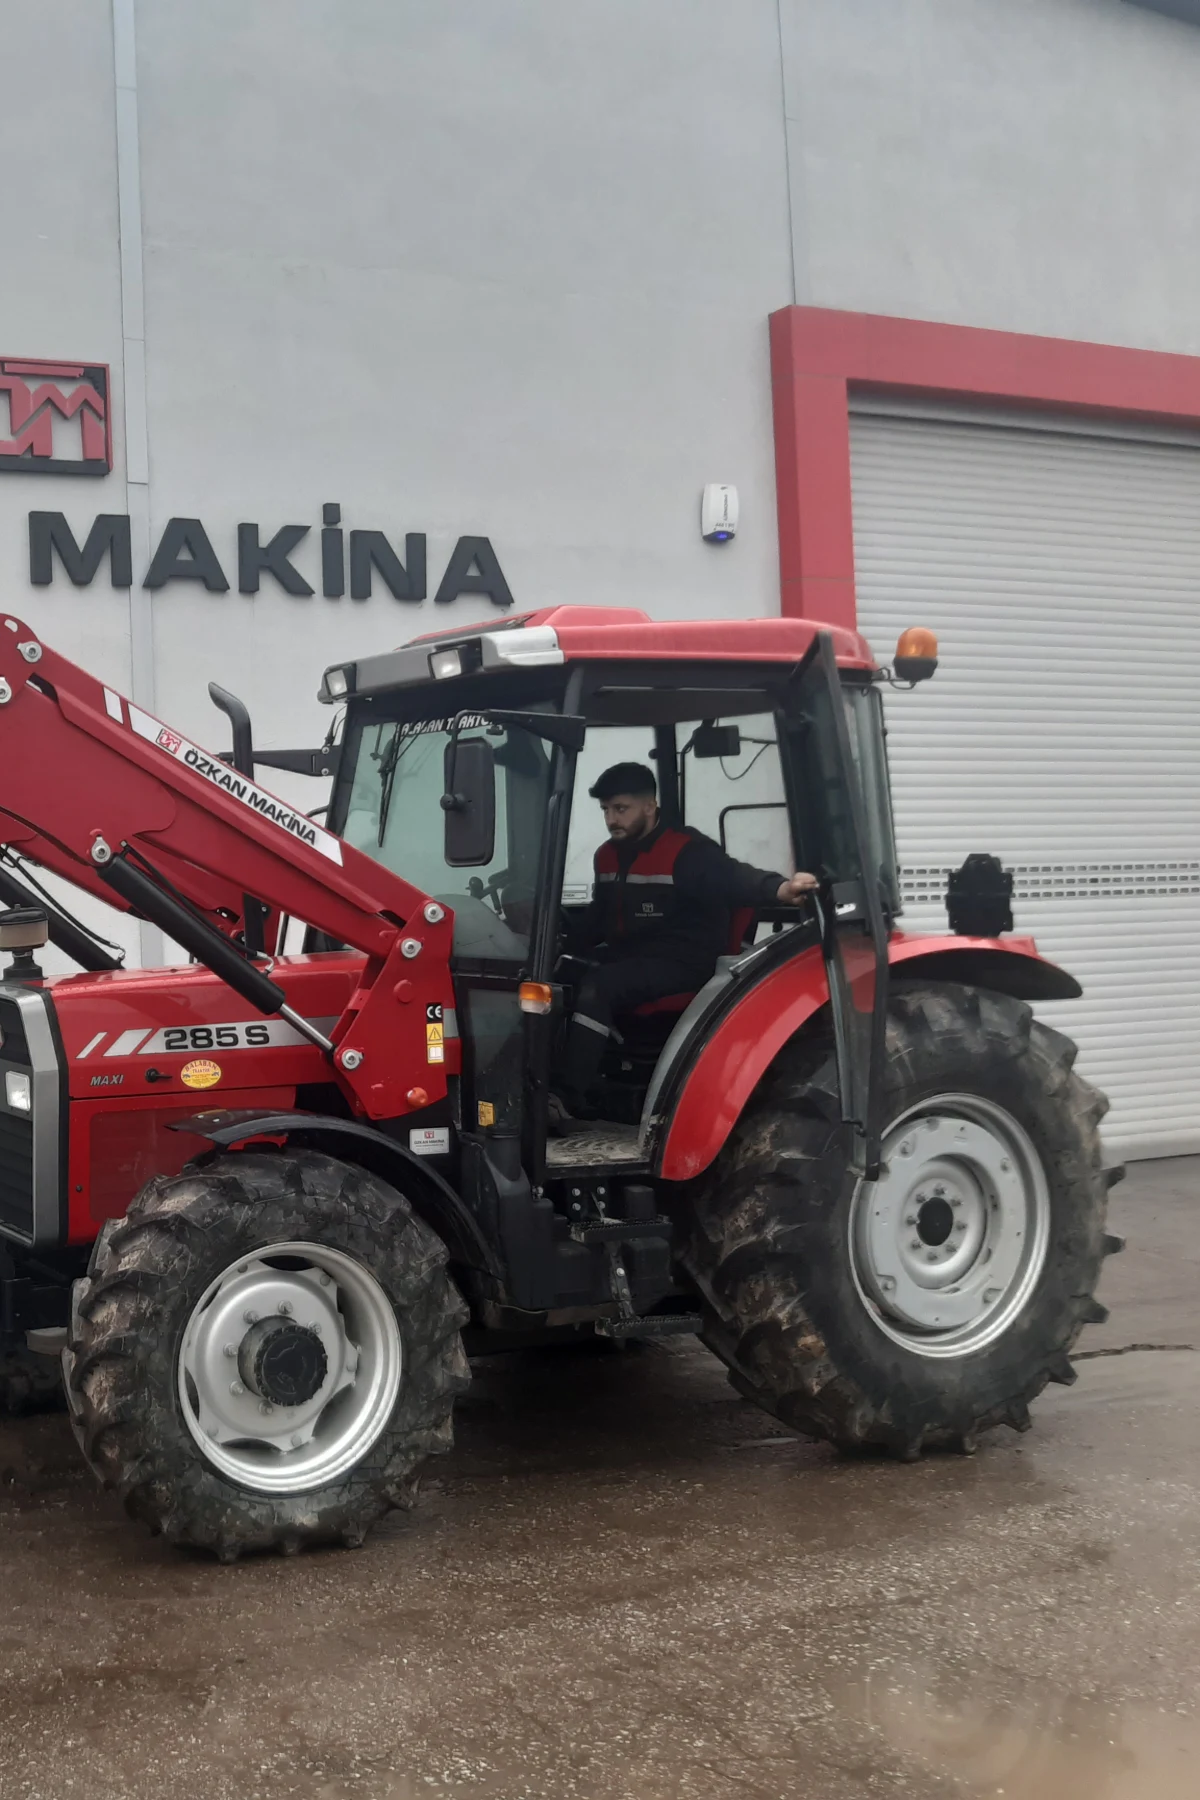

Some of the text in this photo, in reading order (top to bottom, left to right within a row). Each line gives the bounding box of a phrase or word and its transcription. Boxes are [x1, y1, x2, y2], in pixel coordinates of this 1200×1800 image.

[28, 502, 515, 604] MAKİNA
[184, 748, 316, 845] ÖZKAN MAKİNA
[163, 1025, 270, 1050] 285 S
[90, 1074, 124, 1086] MAXI
